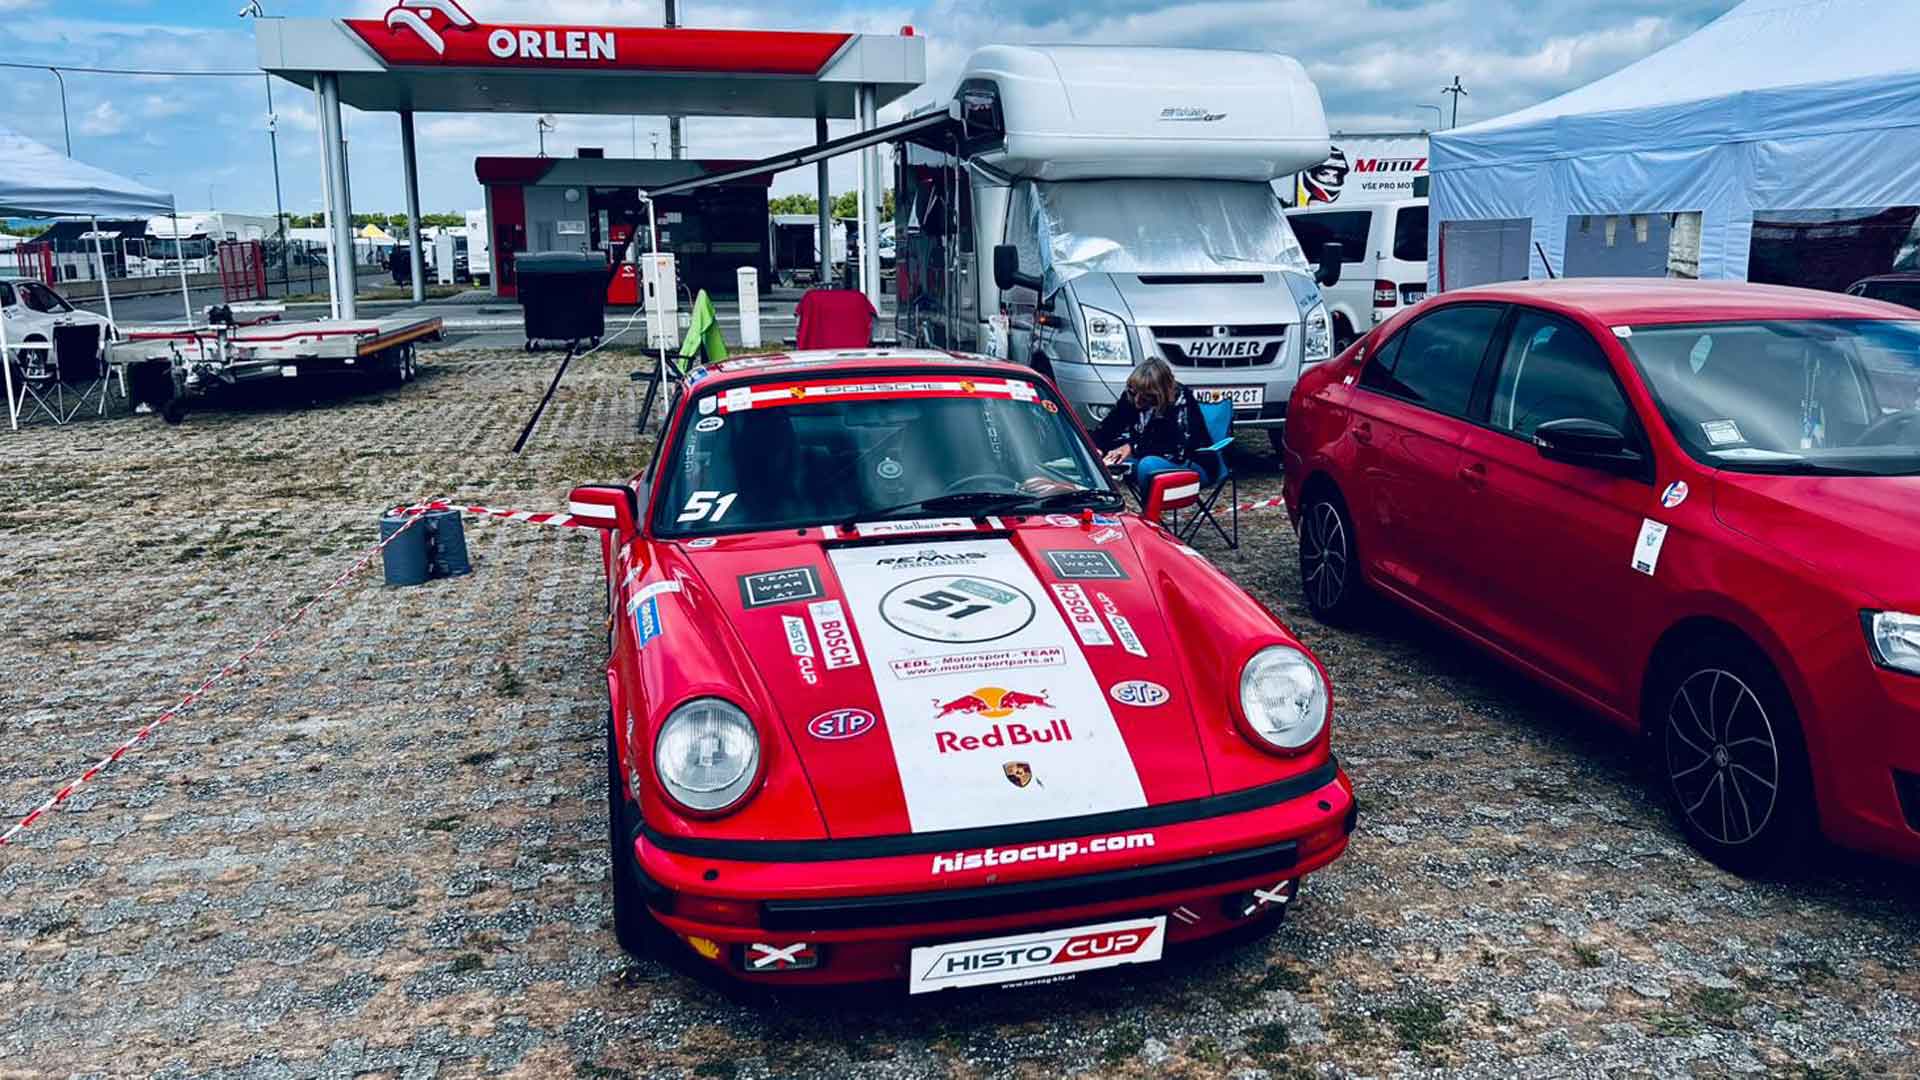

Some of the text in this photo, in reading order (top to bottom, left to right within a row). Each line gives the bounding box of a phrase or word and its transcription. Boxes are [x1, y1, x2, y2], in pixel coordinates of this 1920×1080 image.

[488, 29, 616, 60] ORLEN
[1379, 182, 1395, 190] PRO
[1190, 341, 1260, 356] HYMER
[824, 383, 944, 393] PORSCHE
[676, 491, 738, 523] 51
[876, 552, 987, 566] REMUS
[758, 572, 799, 583] TEAM
[758, 581, 802, 591] WEAR
[903, 590, 992, 619] 51
[1056, 584, 1095, 623] BOSCH
[821, 620, 854, 667] BOSCH
[894, 660, 931, 670] LEDL
[942, 652, 1010, 665] Motorsport
[1021, 649, 1060, 657] TEAM
[905, 657, 1054, 676] www.motorsportparts.at
[1118, 684, 1162, 704] STP
[818, 711, 865, 735] STP
[935, 719, 1073, 754] Red Bull
[931, 832, 1155, 875] histocup.com
